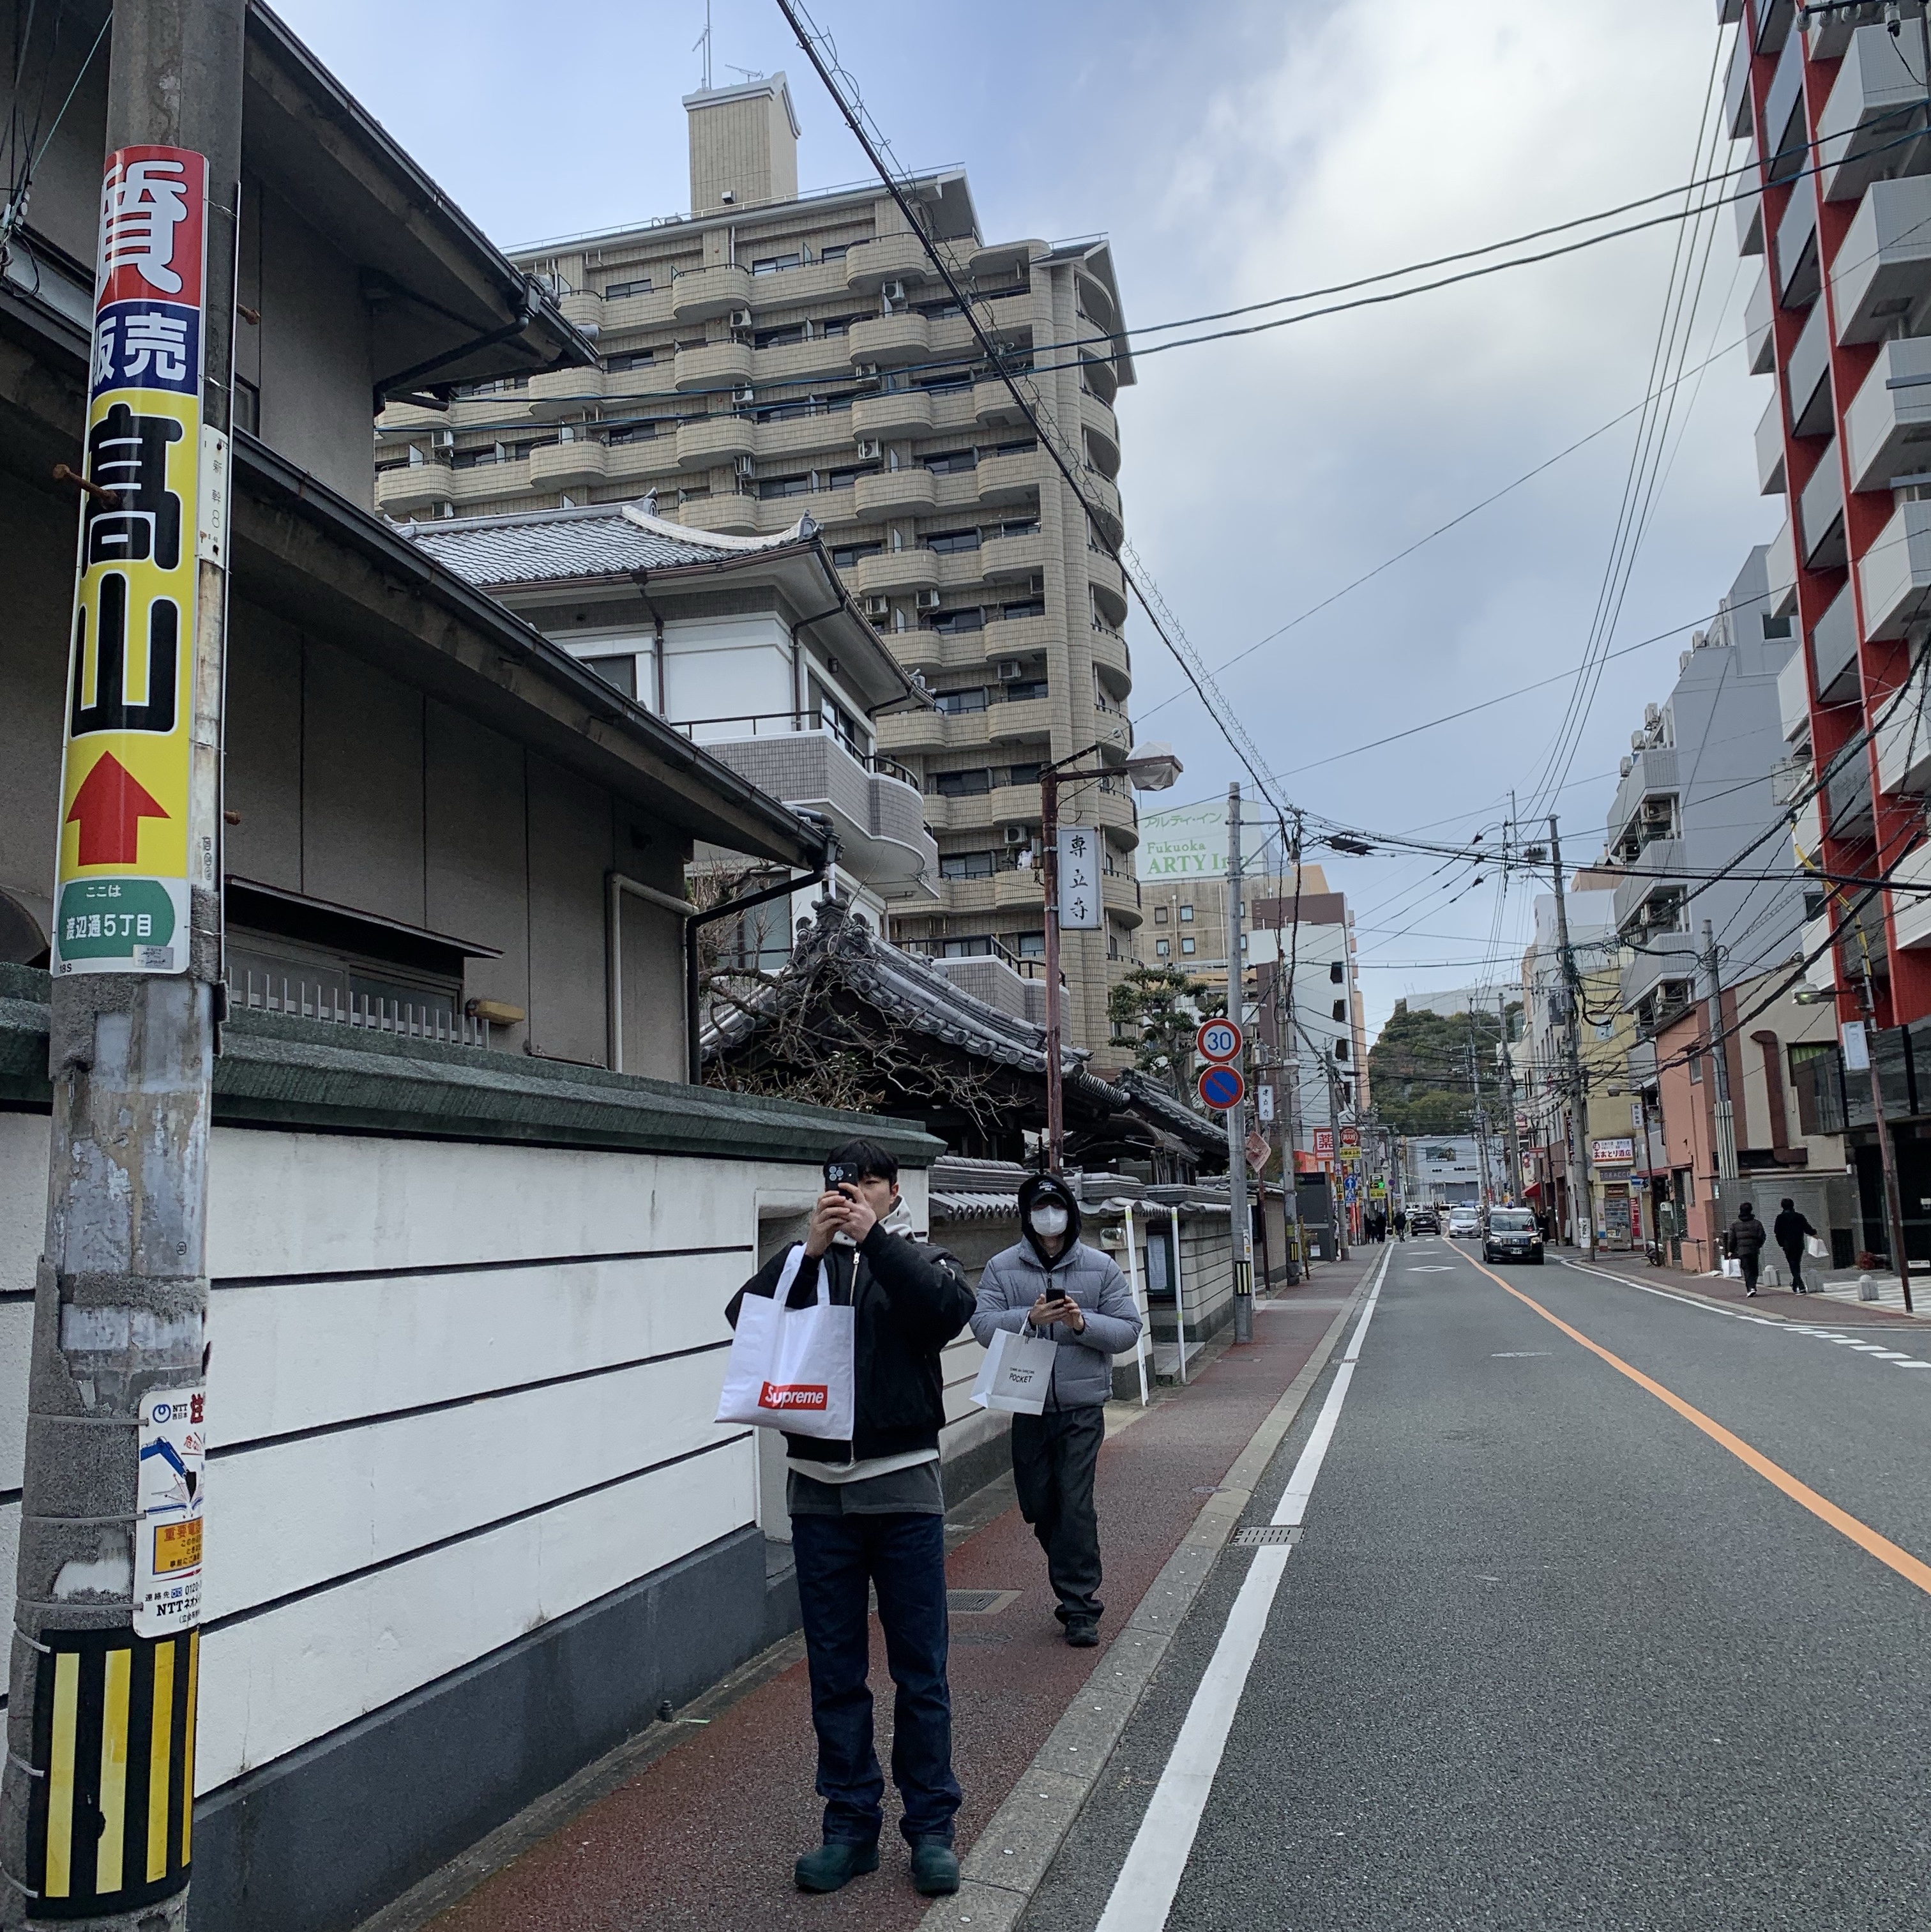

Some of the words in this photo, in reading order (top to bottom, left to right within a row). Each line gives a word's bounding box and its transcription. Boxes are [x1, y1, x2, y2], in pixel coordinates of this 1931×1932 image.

[1147, 839, 1206, 854] Fukuoka
[1147, 854, 1206, 874] ARTY
[1069, 835, 1089, 920] 専立寺
[86, 885, 121, 897] ここは
[1208, 1031, 1232, 1051] 30
[1319, 1133, 1333, 1148] 薬
[1009, 1373, 1033, 1383] POCKET
[765, 1385, 824, 1408] Supreme
